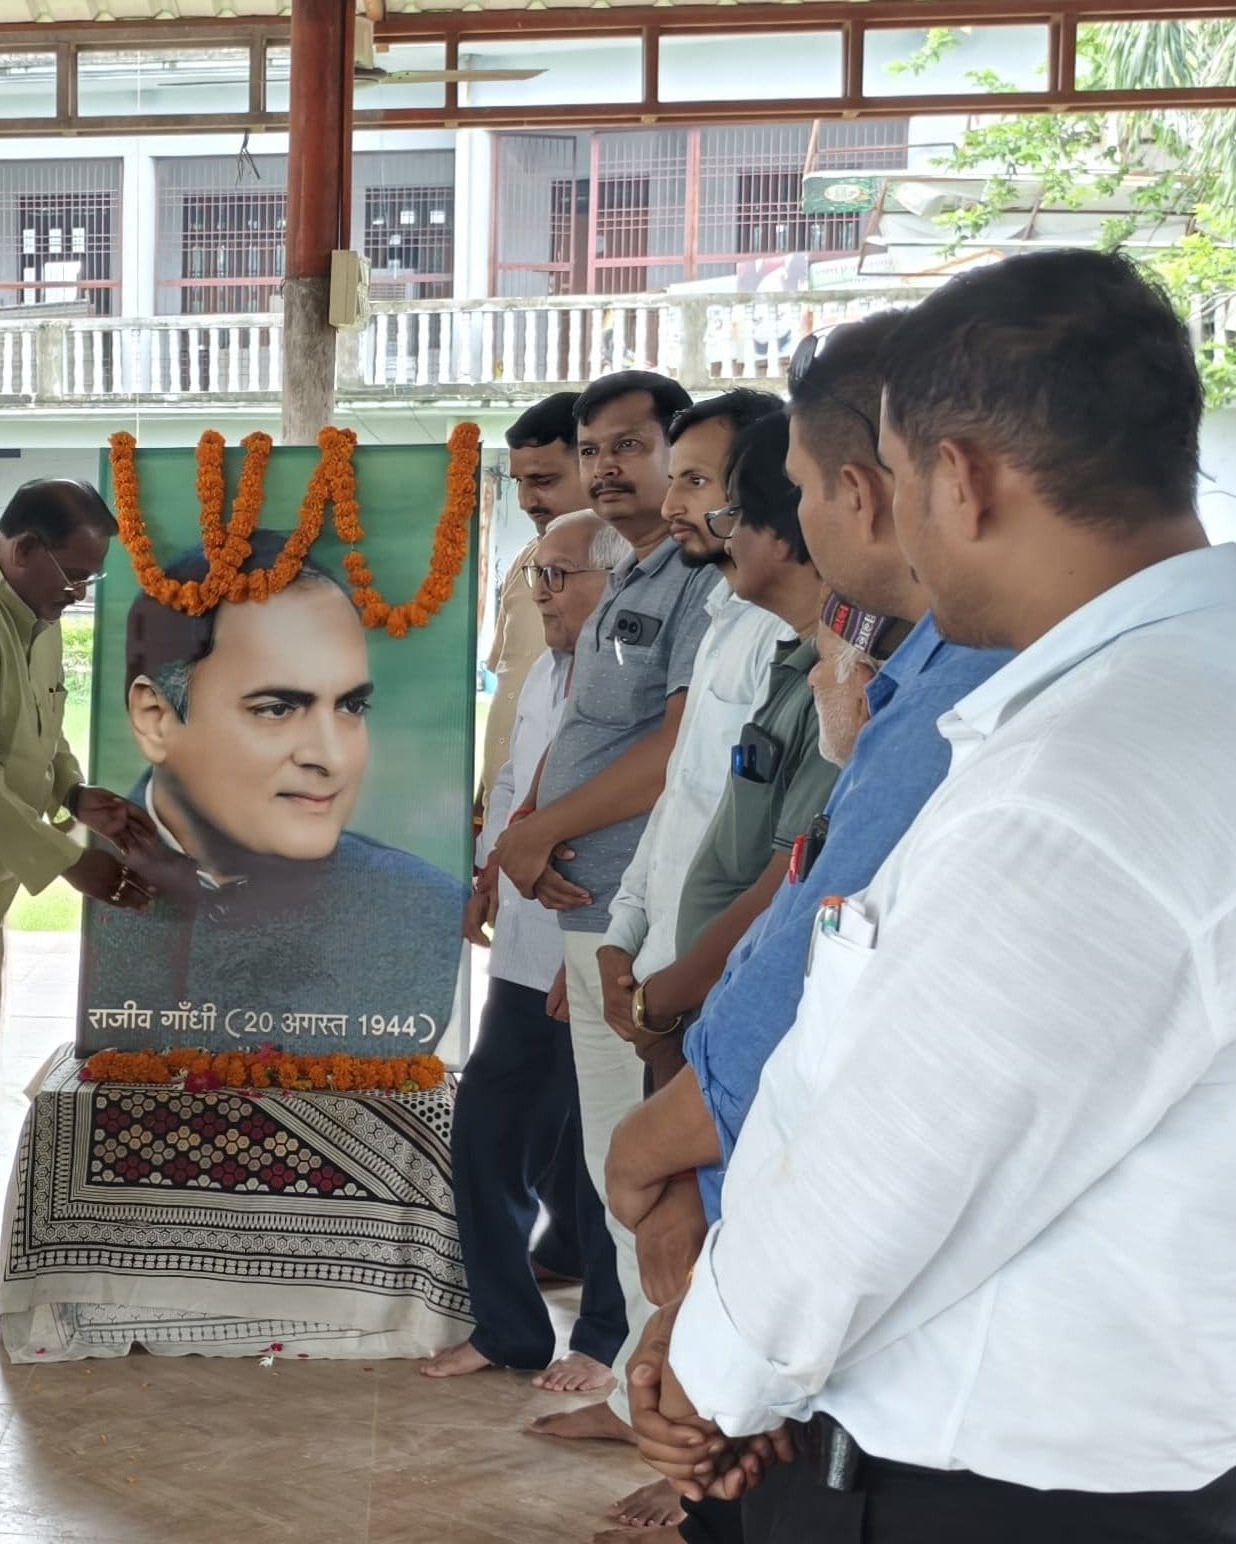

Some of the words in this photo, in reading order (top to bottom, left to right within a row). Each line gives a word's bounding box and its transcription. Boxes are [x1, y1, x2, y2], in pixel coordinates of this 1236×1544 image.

[88, 1000, 153, 1029] राजीव
[160, 1001, 217, 1031] गाँधी
[281, 1013, 349, 1037] अगस्त
[358, 1013, 437, 1043] 1944)
